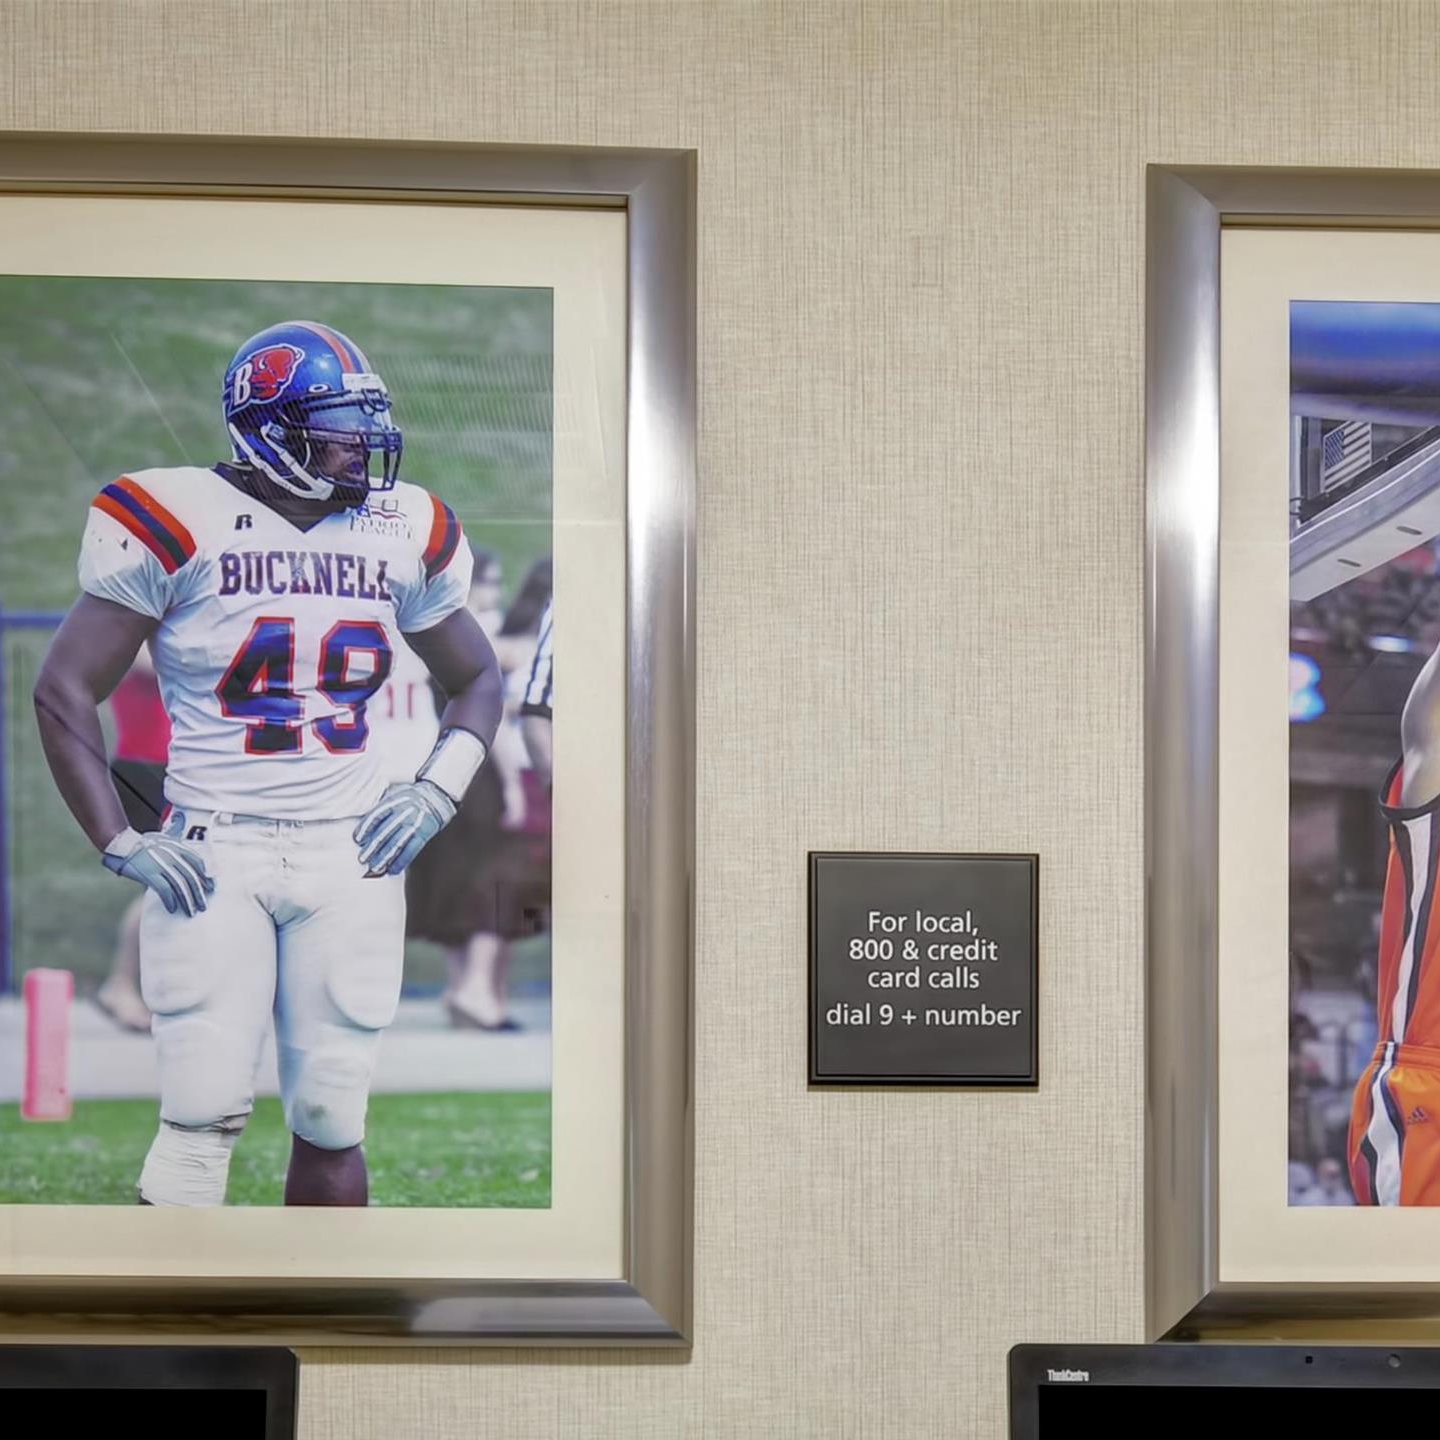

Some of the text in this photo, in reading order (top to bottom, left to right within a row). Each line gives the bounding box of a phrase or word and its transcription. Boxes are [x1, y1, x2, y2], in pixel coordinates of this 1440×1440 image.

[218, 550, 393, 601] BUCKNELL
[213, 616, 394, 756] 49
[868, 910, 979, 937] For local,
[848, 939, 999, 961] 800 & credit
[867, 966, 981, 989] card calls
[826, 1003, 1022, 1026] dial 9 + number
